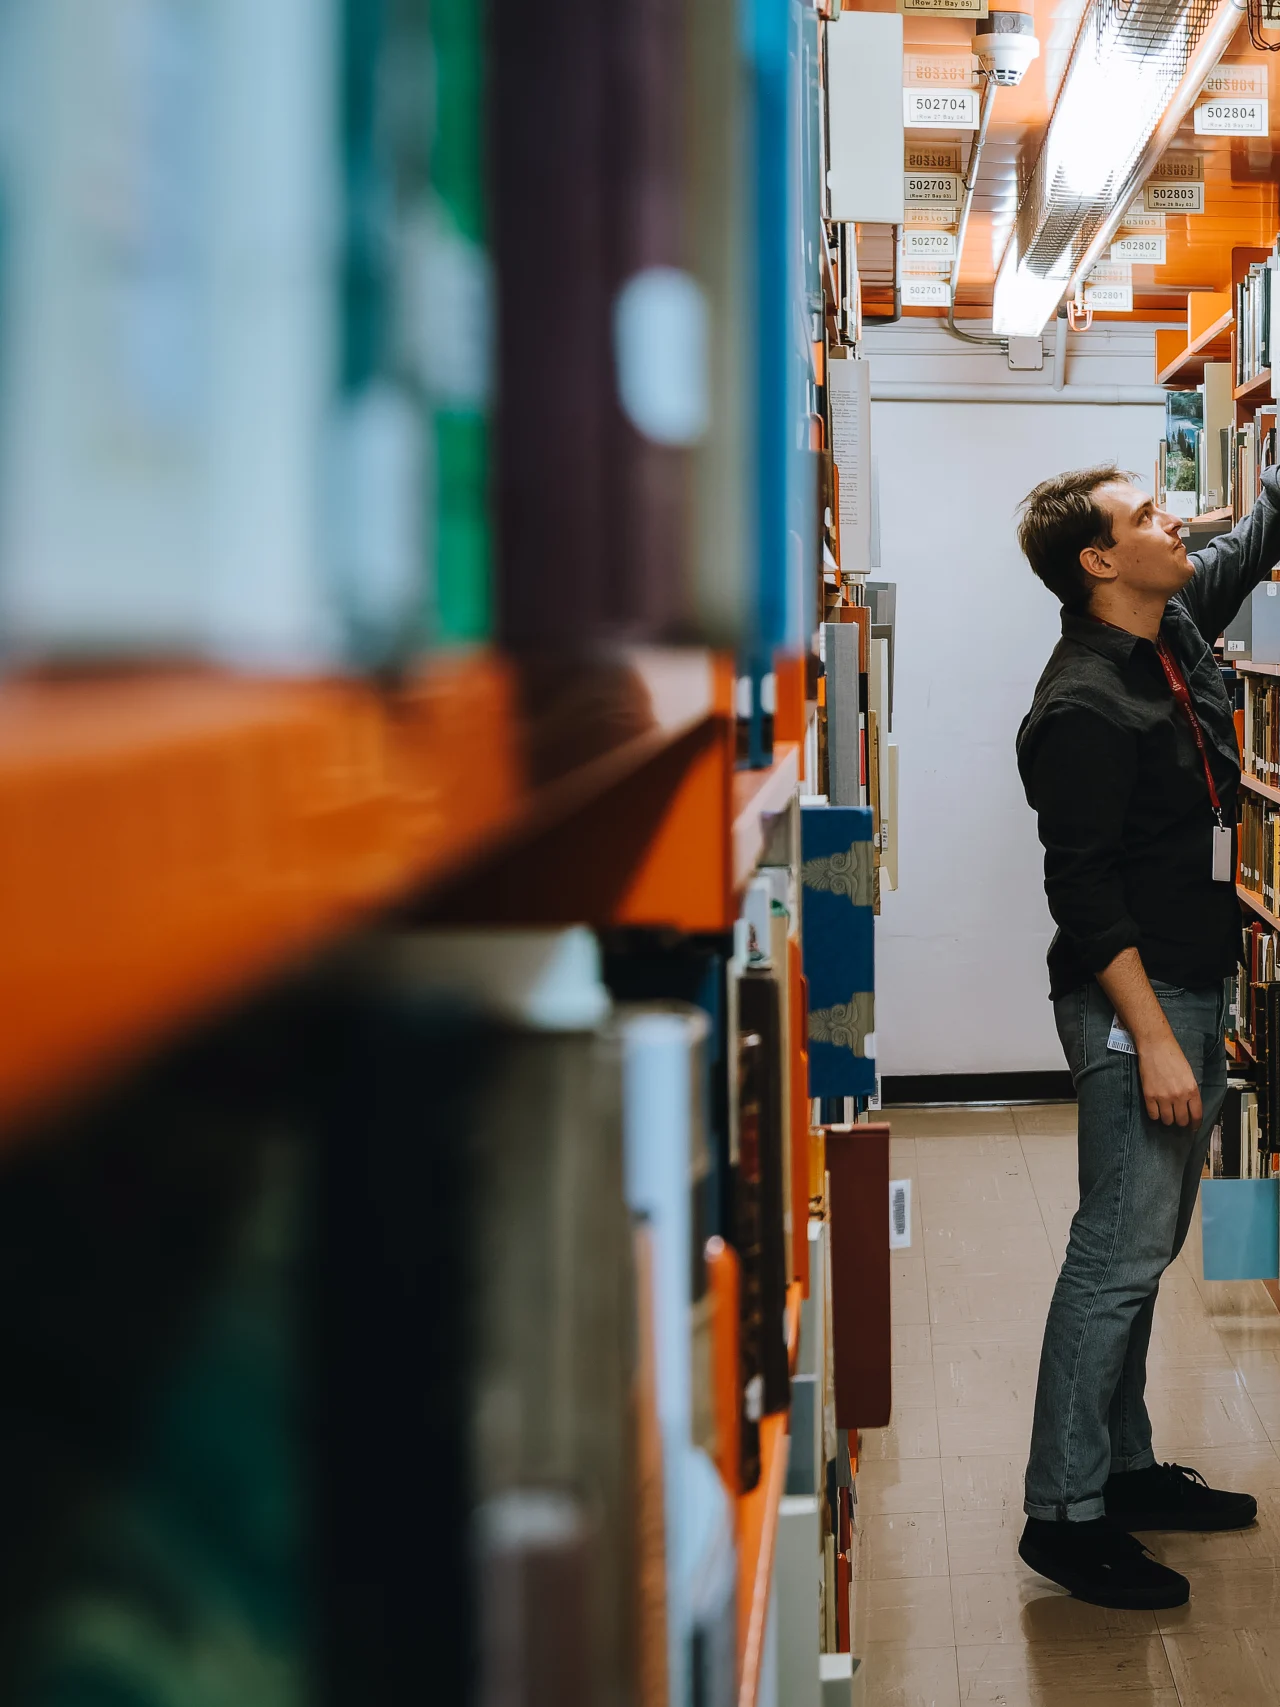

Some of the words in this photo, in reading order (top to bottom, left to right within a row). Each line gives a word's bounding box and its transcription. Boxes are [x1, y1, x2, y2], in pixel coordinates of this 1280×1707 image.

[945, 0, 958, 8] Bay
[916, 98, 966, 110] 502704
[1207, 107, 1256, 119] 502804
[909, 180, 952, 190] 502703
[1153, 189, 1194, 199] 502803
[911, 237, 949, 246] 502702
[1120, 241, 1157, 250] 502802
[910, 286, 942, 294] 502701
[1092, 291, 1123, 300] 502801
